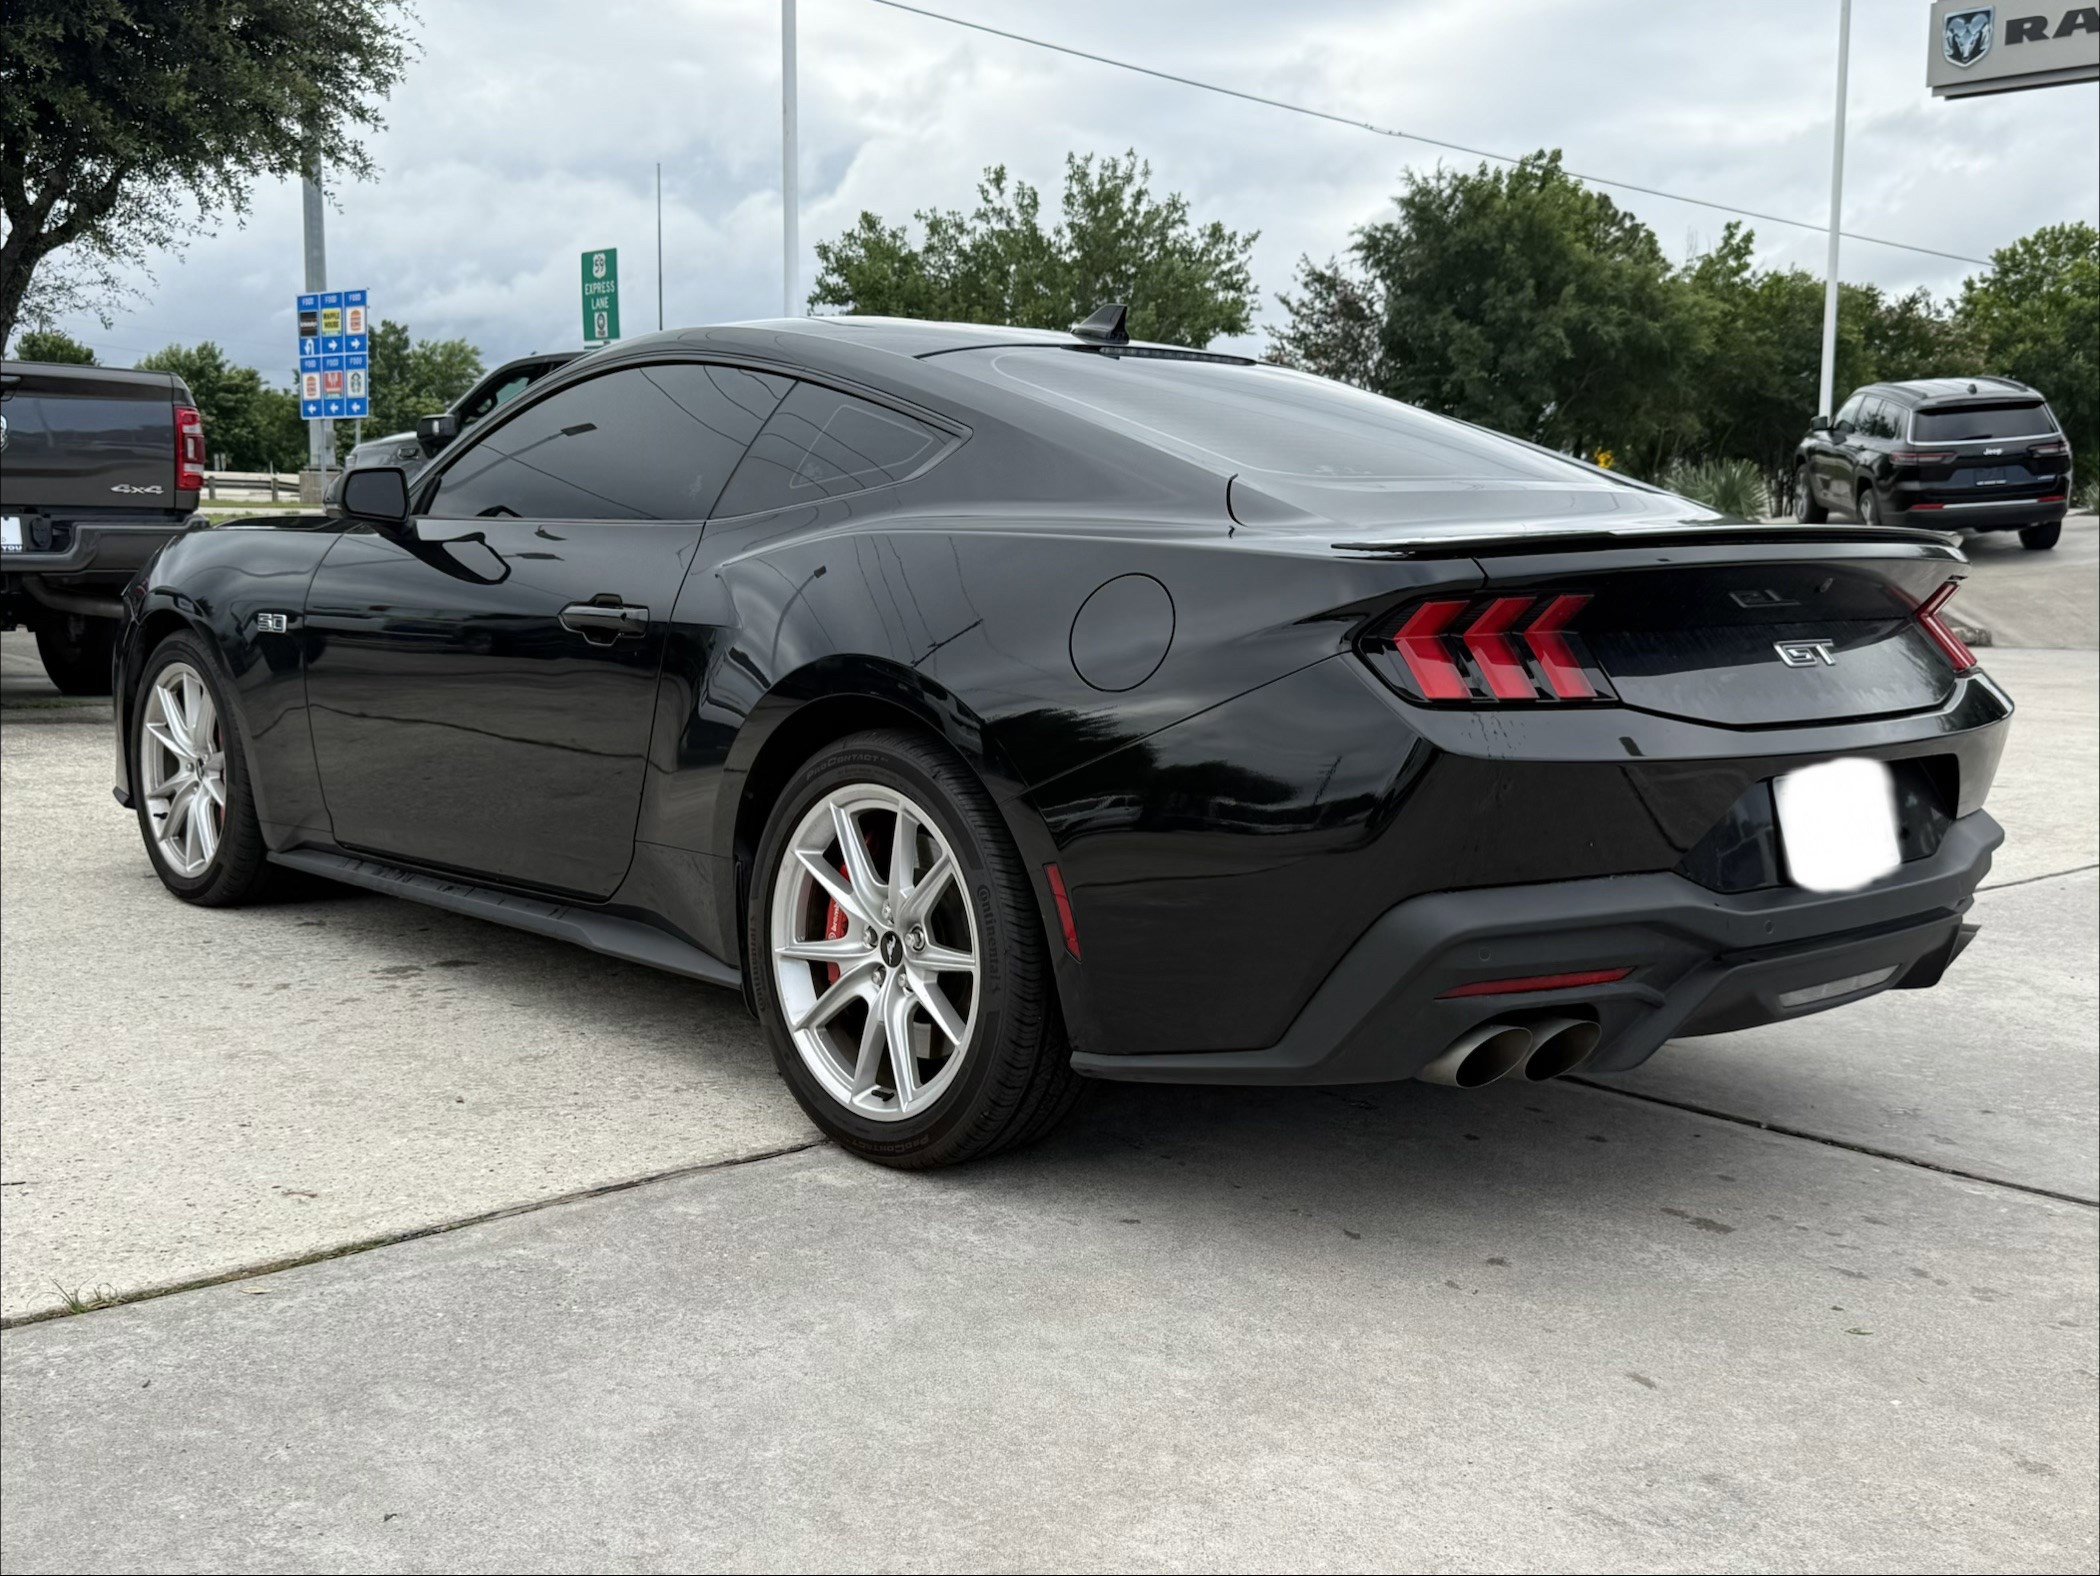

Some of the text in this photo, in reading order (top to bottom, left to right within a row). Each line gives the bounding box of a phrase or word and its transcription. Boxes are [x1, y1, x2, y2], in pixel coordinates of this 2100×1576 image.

[595, 258, 604, 273] 59
[585, 281, 615, 295] EXPRESS
[302, 297, 314, 306] FOOD
[324, 295, 337, 304] FOOD
[349, 293, 361, 302] FOOD
[591, 296, 609, 310] LANE
[305, 359, 316, 368] FOOD
[326, 358, 339, 367] FOOD
[350, 357, 362, 365] FOOD
[1983, 448, 2003, 456] Jeep
[110, 484, 164, 494] 4x4
[1773, 638, 1836, 668] GT
